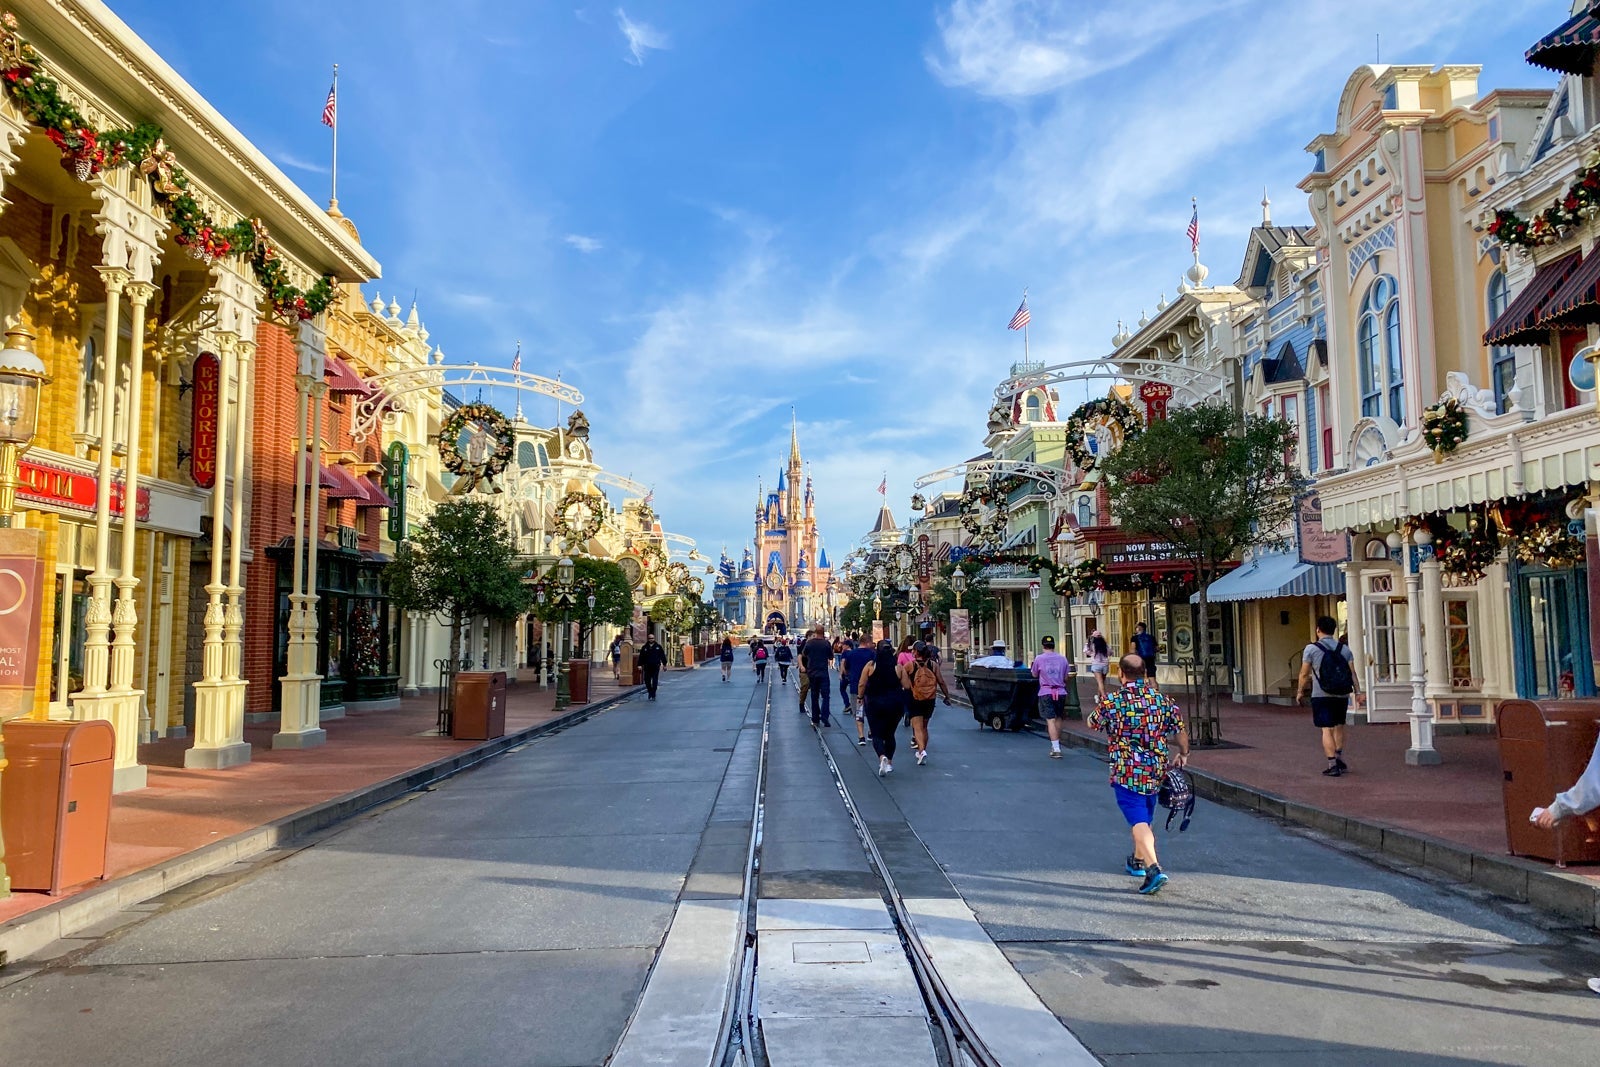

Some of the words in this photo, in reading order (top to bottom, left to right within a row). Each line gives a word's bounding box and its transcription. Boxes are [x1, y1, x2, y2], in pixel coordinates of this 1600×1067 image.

[1143, 385, 1168, 395] MAIN
[196, 367, 213, 472] EMPORIUM
[392, 450, 400, 532] ARCADE
[1126, 543, 1146, 552] NOW
[1127, 554, 1157, 562] YEARS
[1159, 552, 1171, 560] OF
